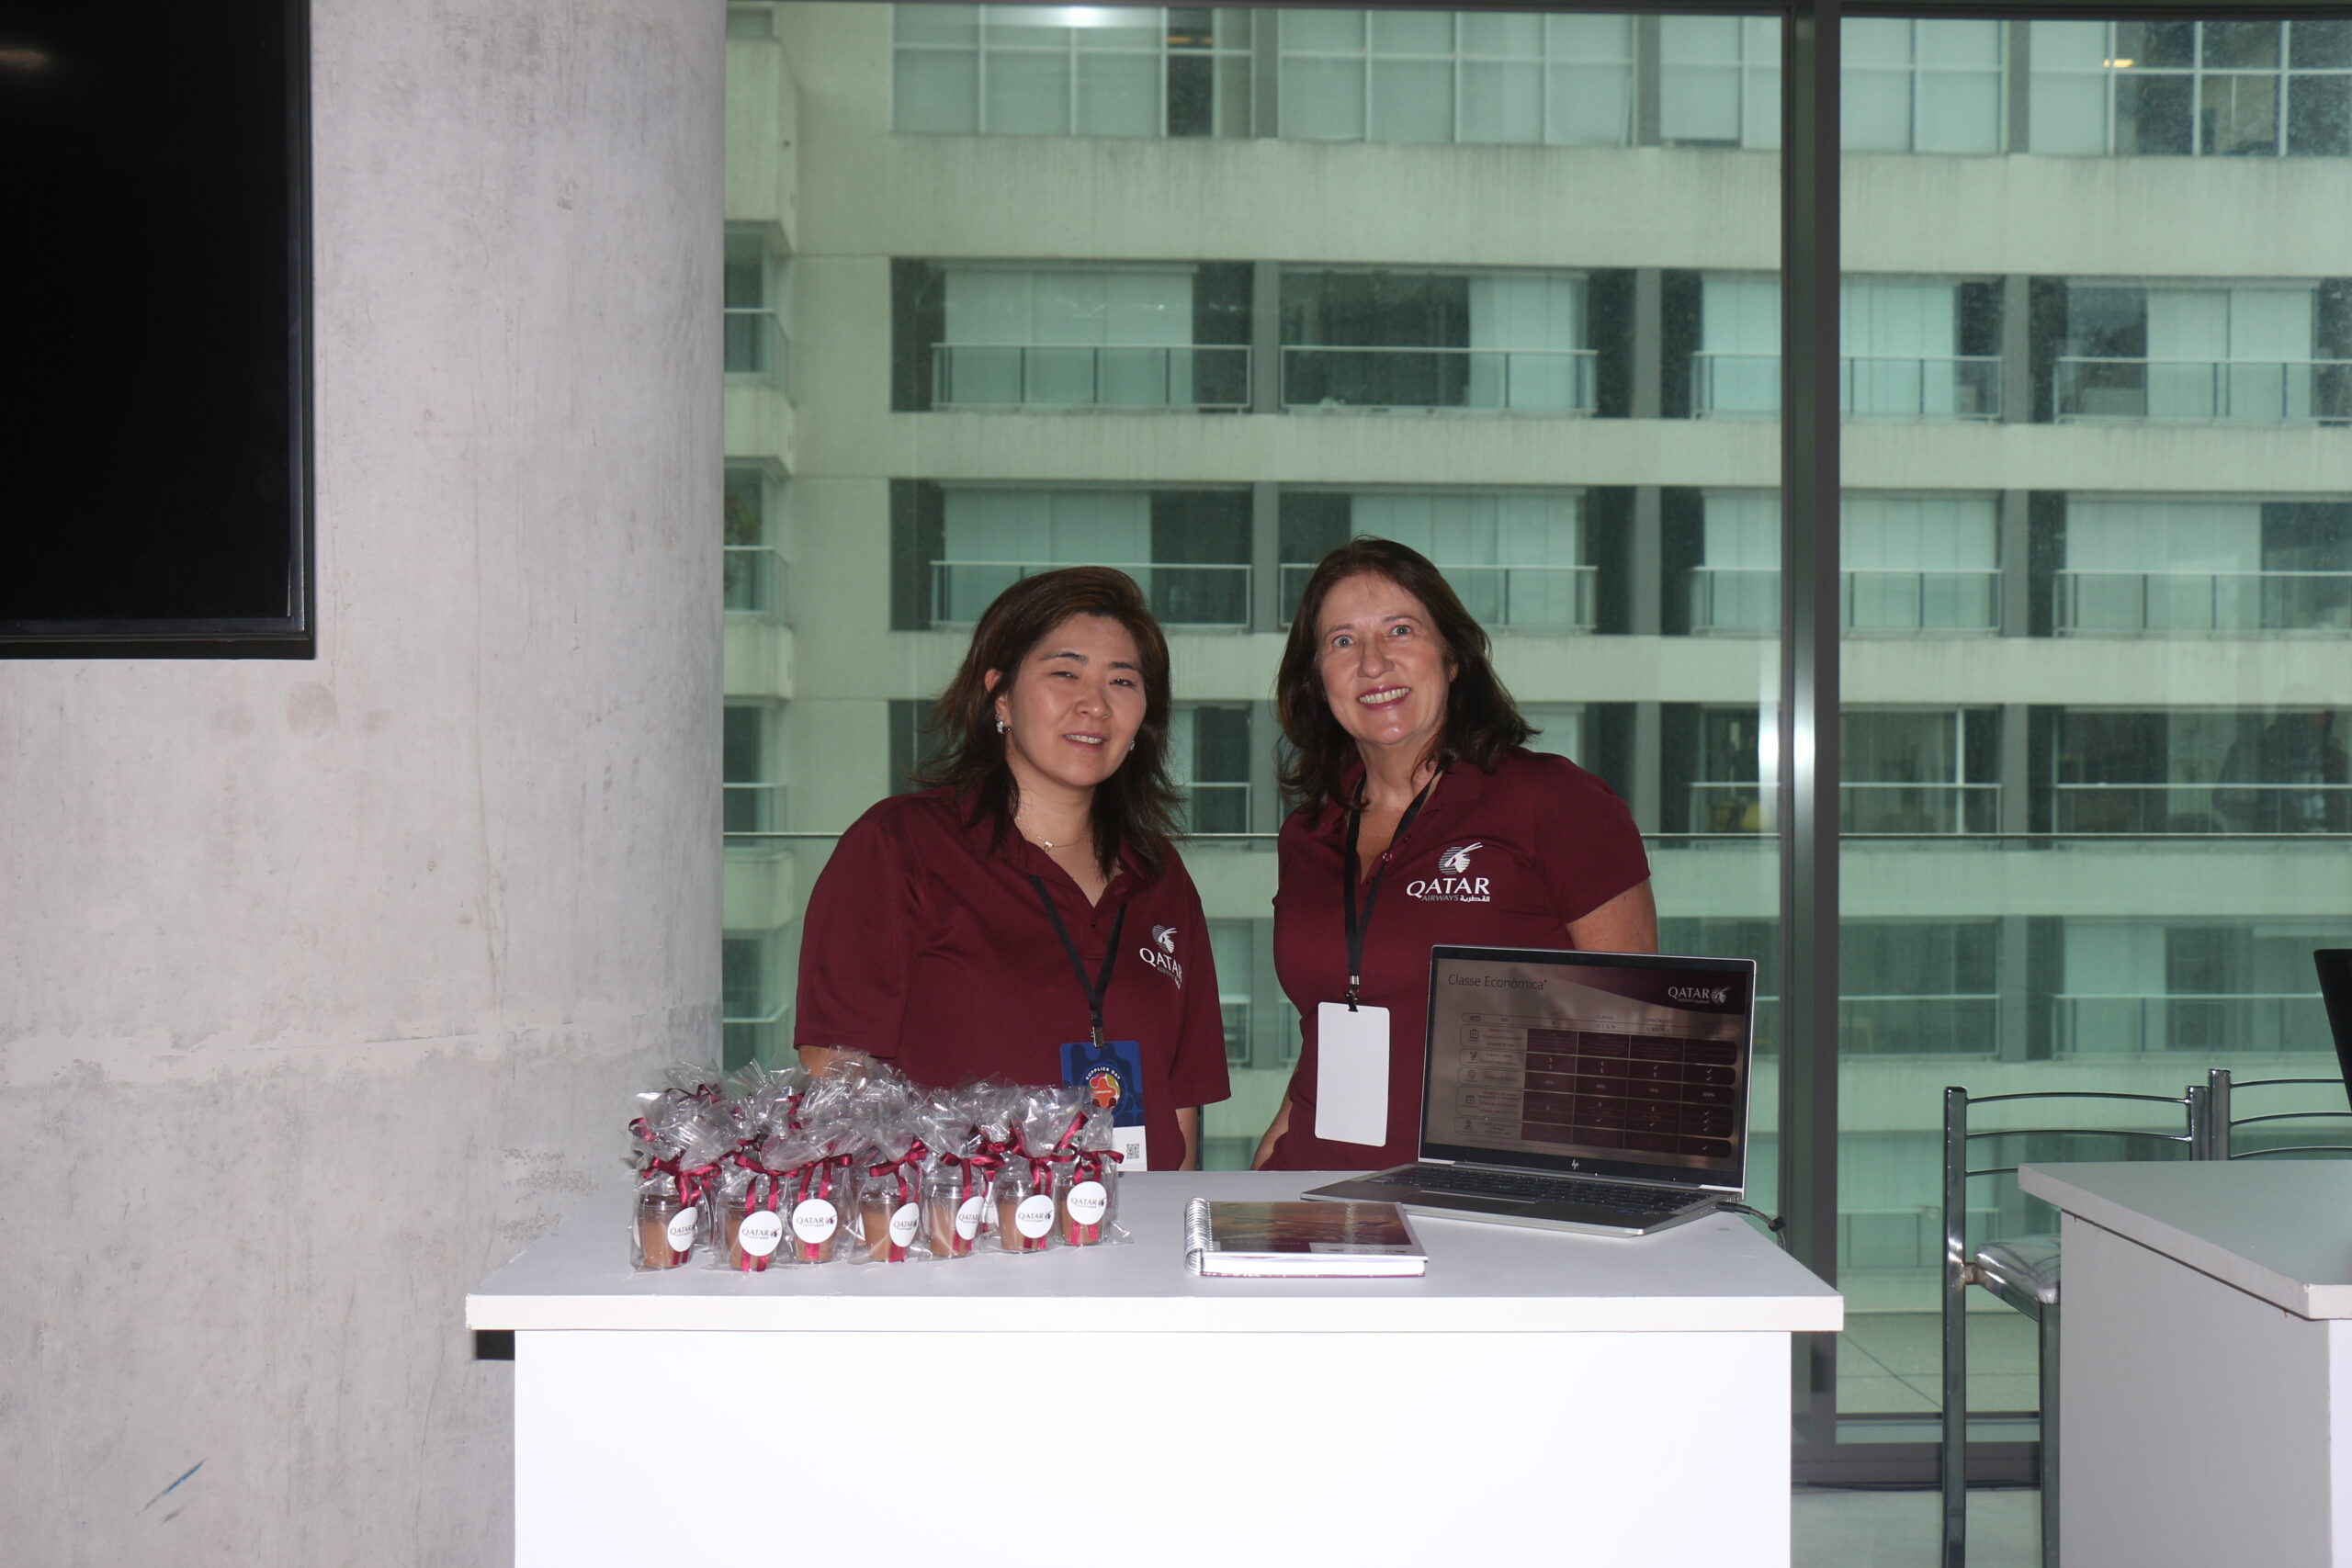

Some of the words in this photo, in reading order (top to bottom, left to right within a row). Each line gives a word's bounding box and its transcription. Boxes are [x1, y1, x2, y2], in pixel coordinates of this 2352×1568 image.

[1406, 877, 1490, 898] QATAR
[1139, 947, 1182, 983] QATAR
[1448, 974, 1481, 987] Classe
[1668, 986, 1710, 999] QATAR
[1085, 1066, 1110, 1080] SUPPLIER
[1111, 1069, 1121, 1080] DAY
[1070, 1197, 1097, 1206] QATAR
[796, 1216, 824, 1225] QATAR
[894, 1220, 913, 1228] QATAR
[670, 1224, 692, 1235] QATAR
[741, 1227, 770, 1236] QATAR
